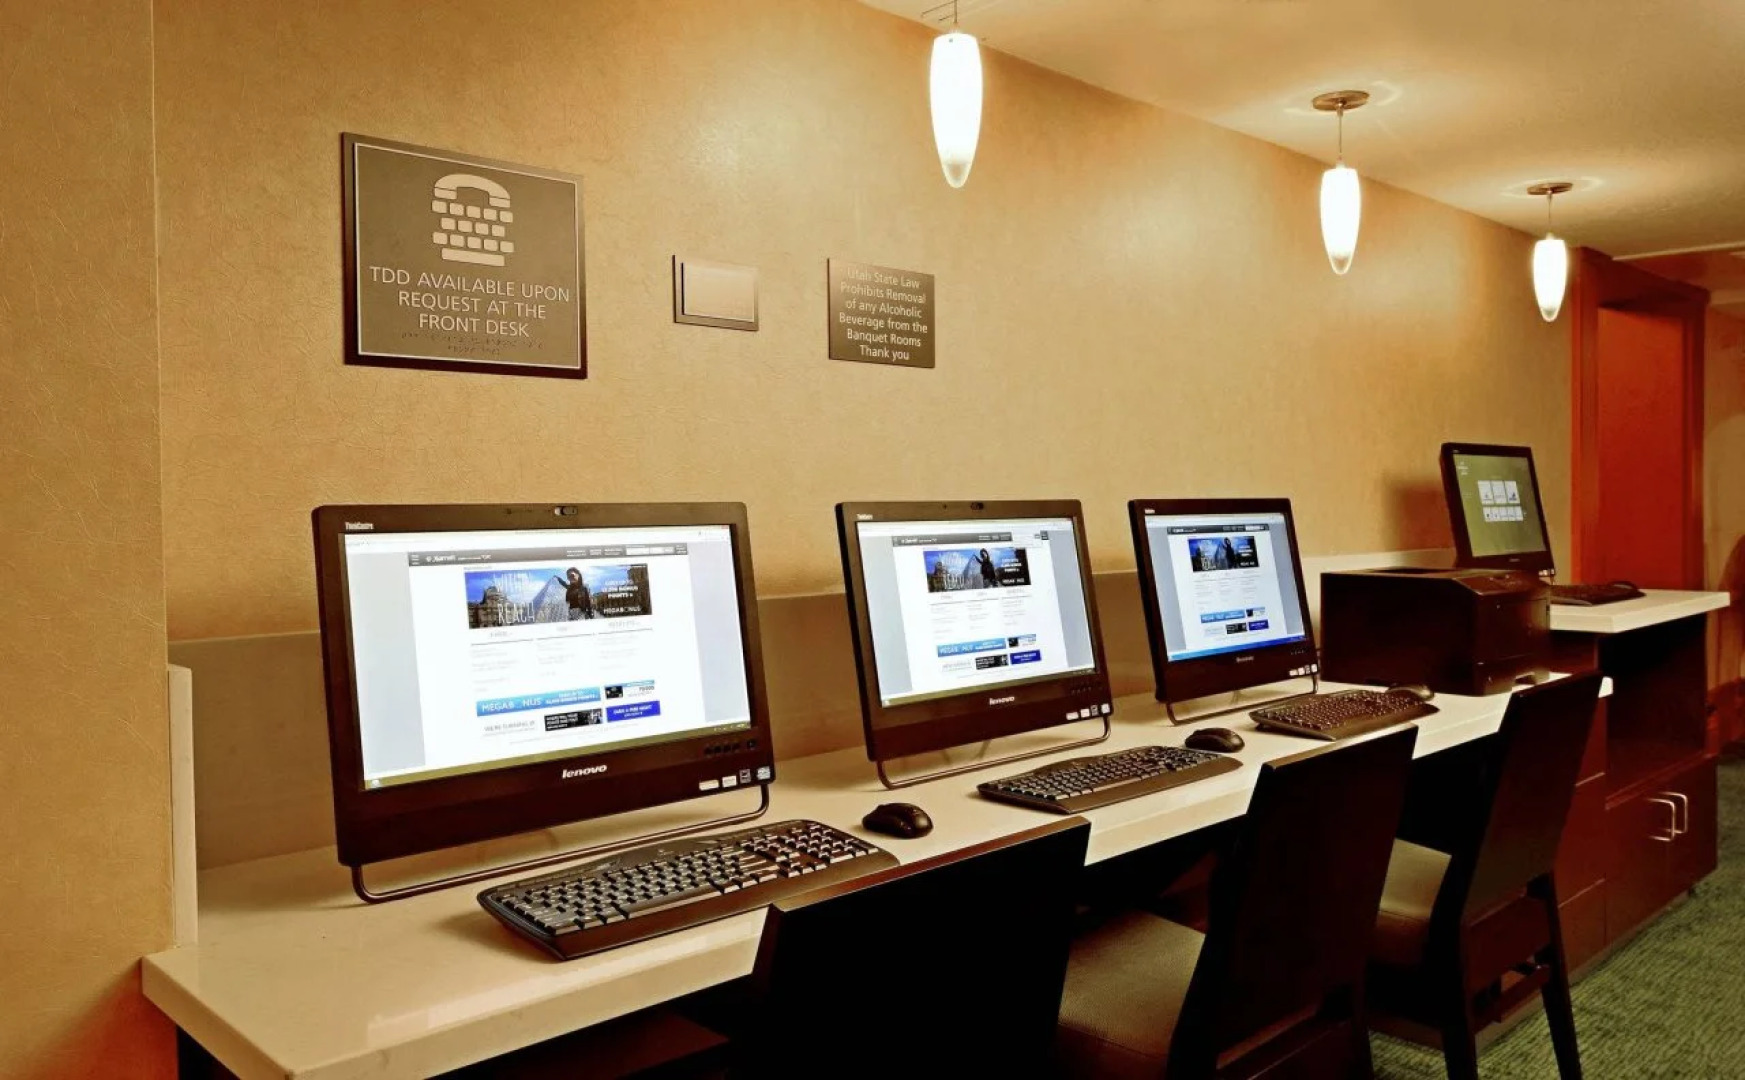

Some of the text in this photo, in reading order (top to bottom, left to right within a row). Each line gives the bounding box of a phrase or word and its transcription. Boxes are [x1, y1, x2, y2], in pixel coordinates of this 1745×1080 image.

[369, 266, 570, 302] TDD AVAILABLE UPON
[847, 268, 920, 289] Utah State Law
[840, 282, 926, 304] Prohibits Removal
[398, 291, 546, 320] REQUEST AT THE
[845, 298, 922, 319] of any Alcoholic
[419, 313, 530, 338] FRONT DESK
[839, 311, 928, 334] Beverage from the
[847, 328, 922, 348] Banquet Rooms
[859, 344, 910, 362] Thank you
[497, 600, 535, 624] REACH
[561, 764, 607, 779] lenovo
